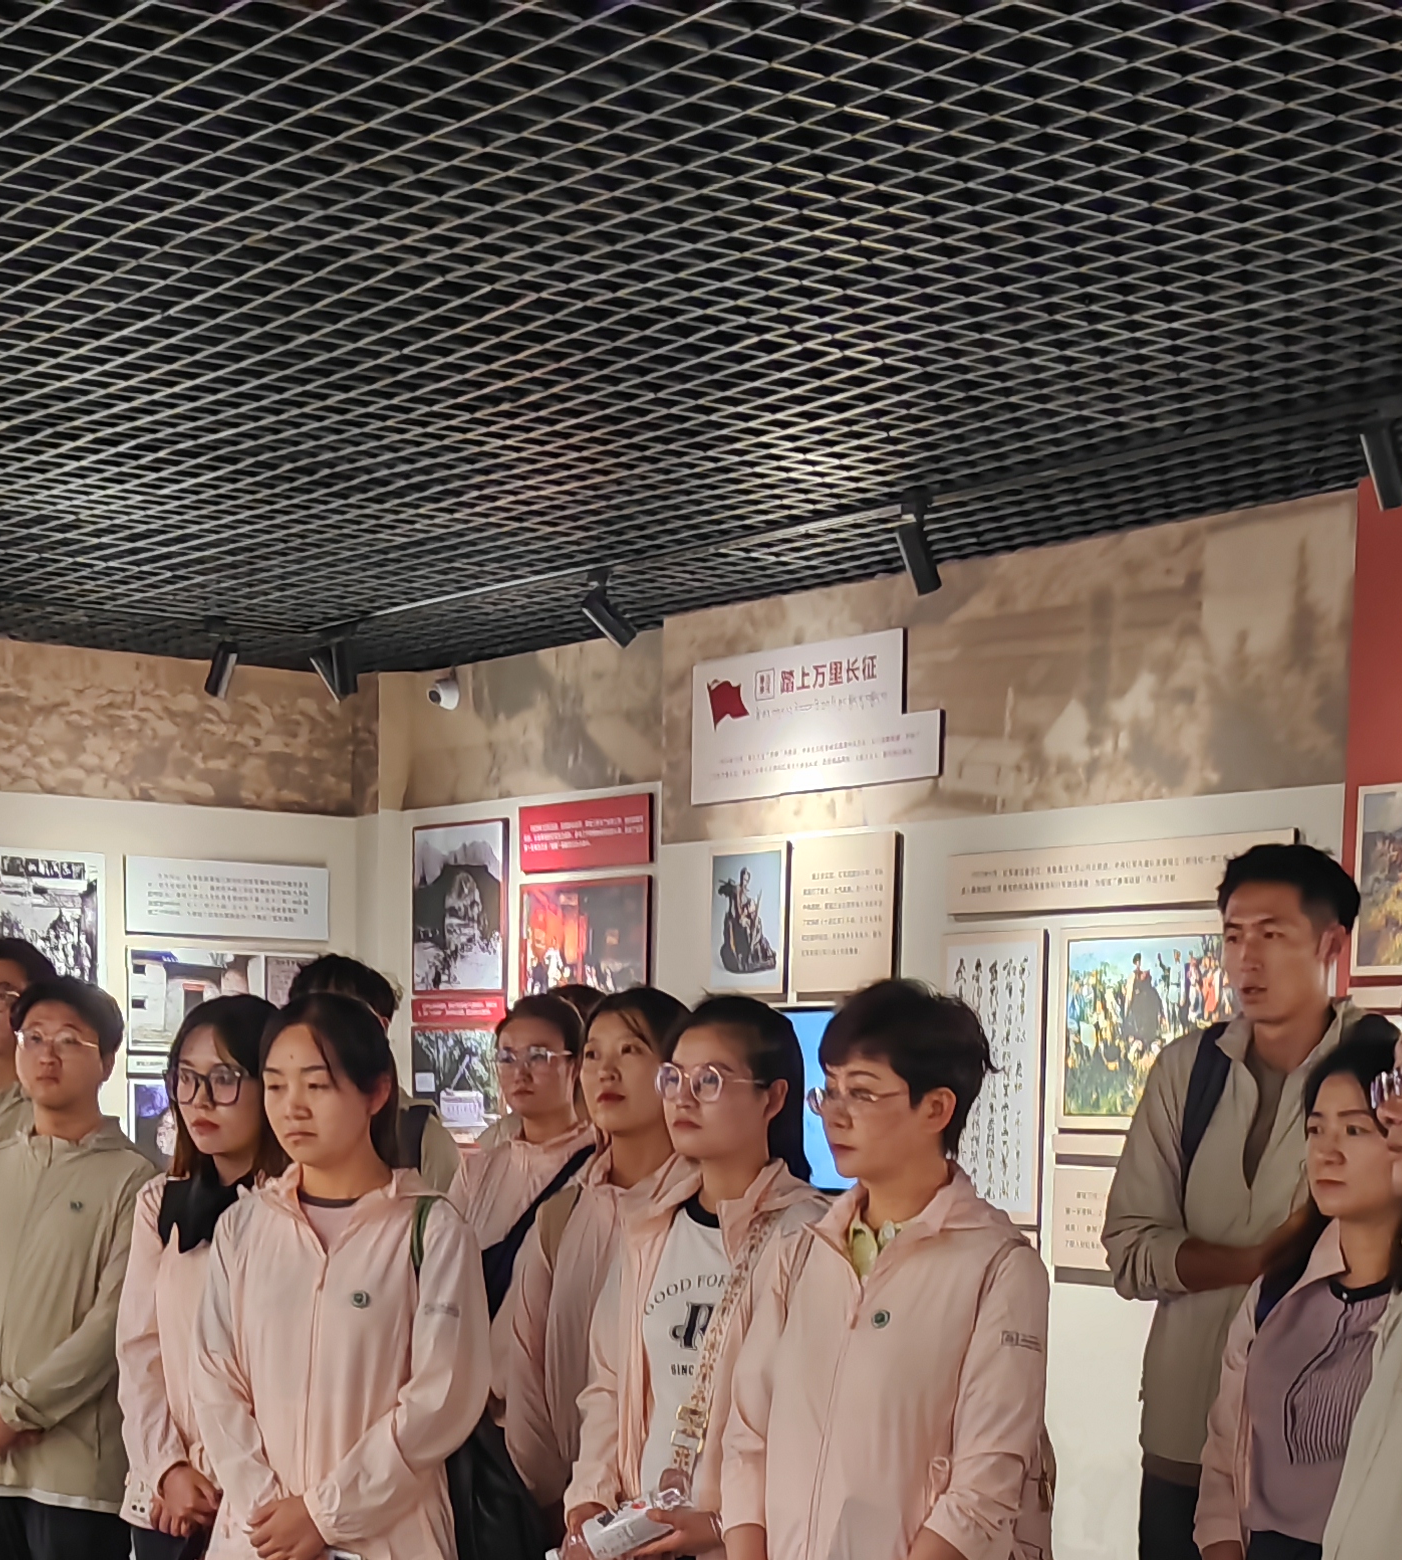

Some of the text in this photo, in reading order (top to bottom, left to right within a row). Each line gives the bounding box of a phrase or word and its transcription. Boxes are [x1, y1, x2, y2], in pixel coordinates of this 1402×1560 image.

[780, 655, 877, 694] 踏上万里长征
[644, 1278, 692, 1316] GOOD
